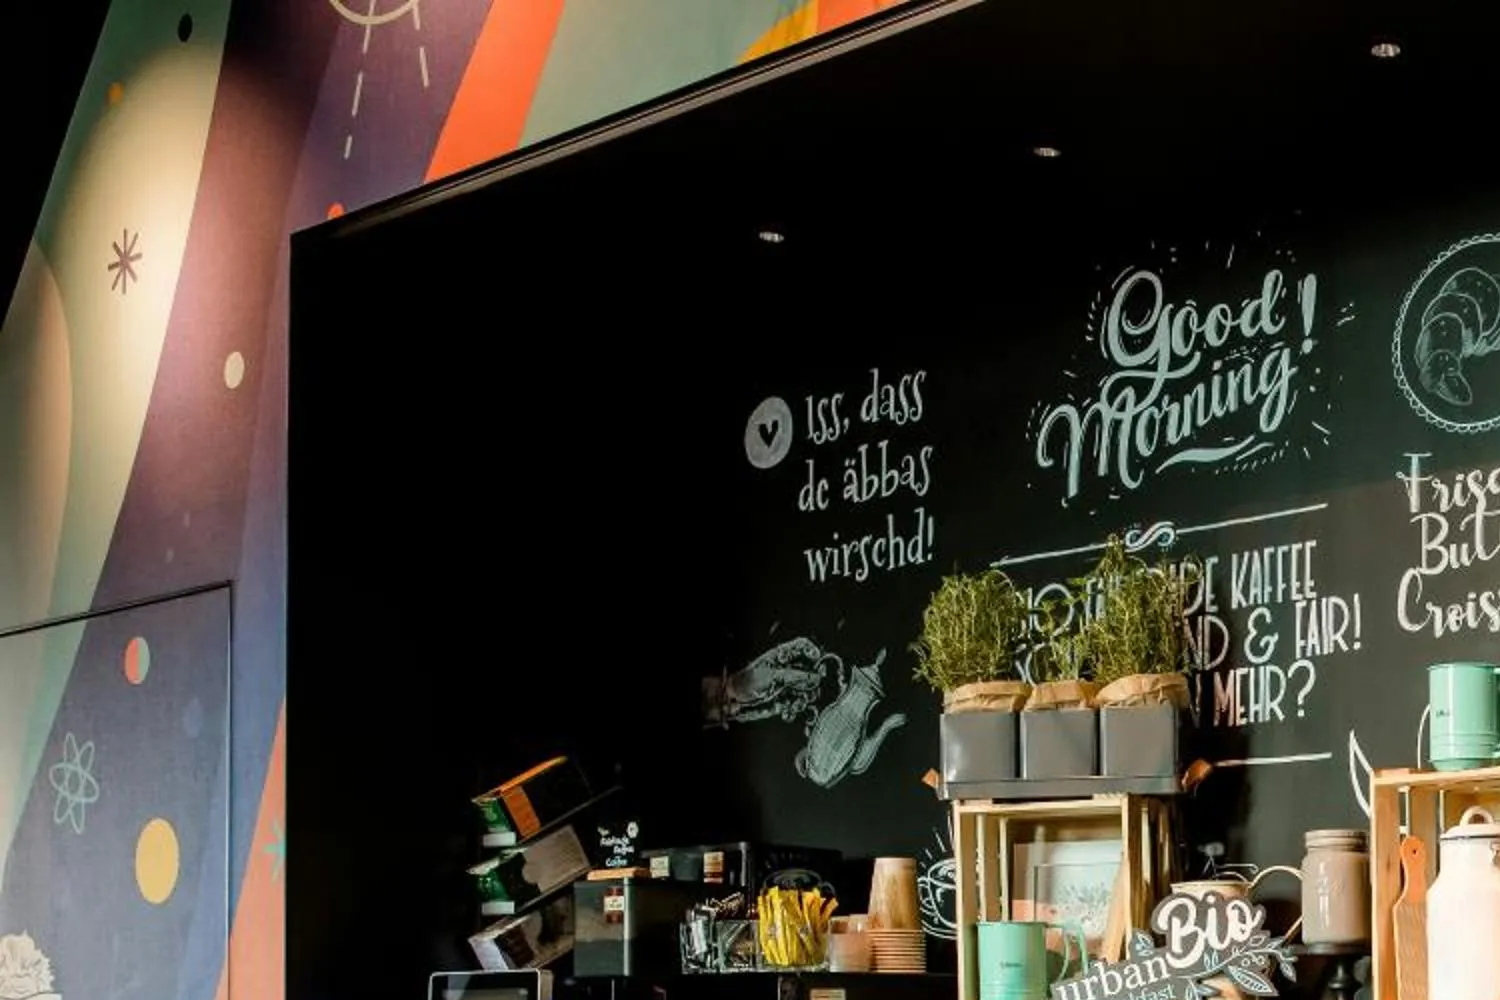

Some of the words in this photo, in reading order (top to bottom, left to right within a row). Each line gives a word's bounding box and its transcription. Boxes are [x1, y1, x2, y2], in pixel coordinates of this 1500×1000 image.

[860, 367, 927, 426] dass
[1037, 345, 1298, 498] Morning
[843, 439, 934, 503] äbbas
[803, 507, 935, 582] wirschd!
[1230, 540, 1318, 610] KAFFEE
[1243, 607, 1279, 664] &
[1294, 593, 1362, 661] FAIR!
[1213, 659, 1317, 728] MEHR?
[1157, 894, 1263, 969] Bio
